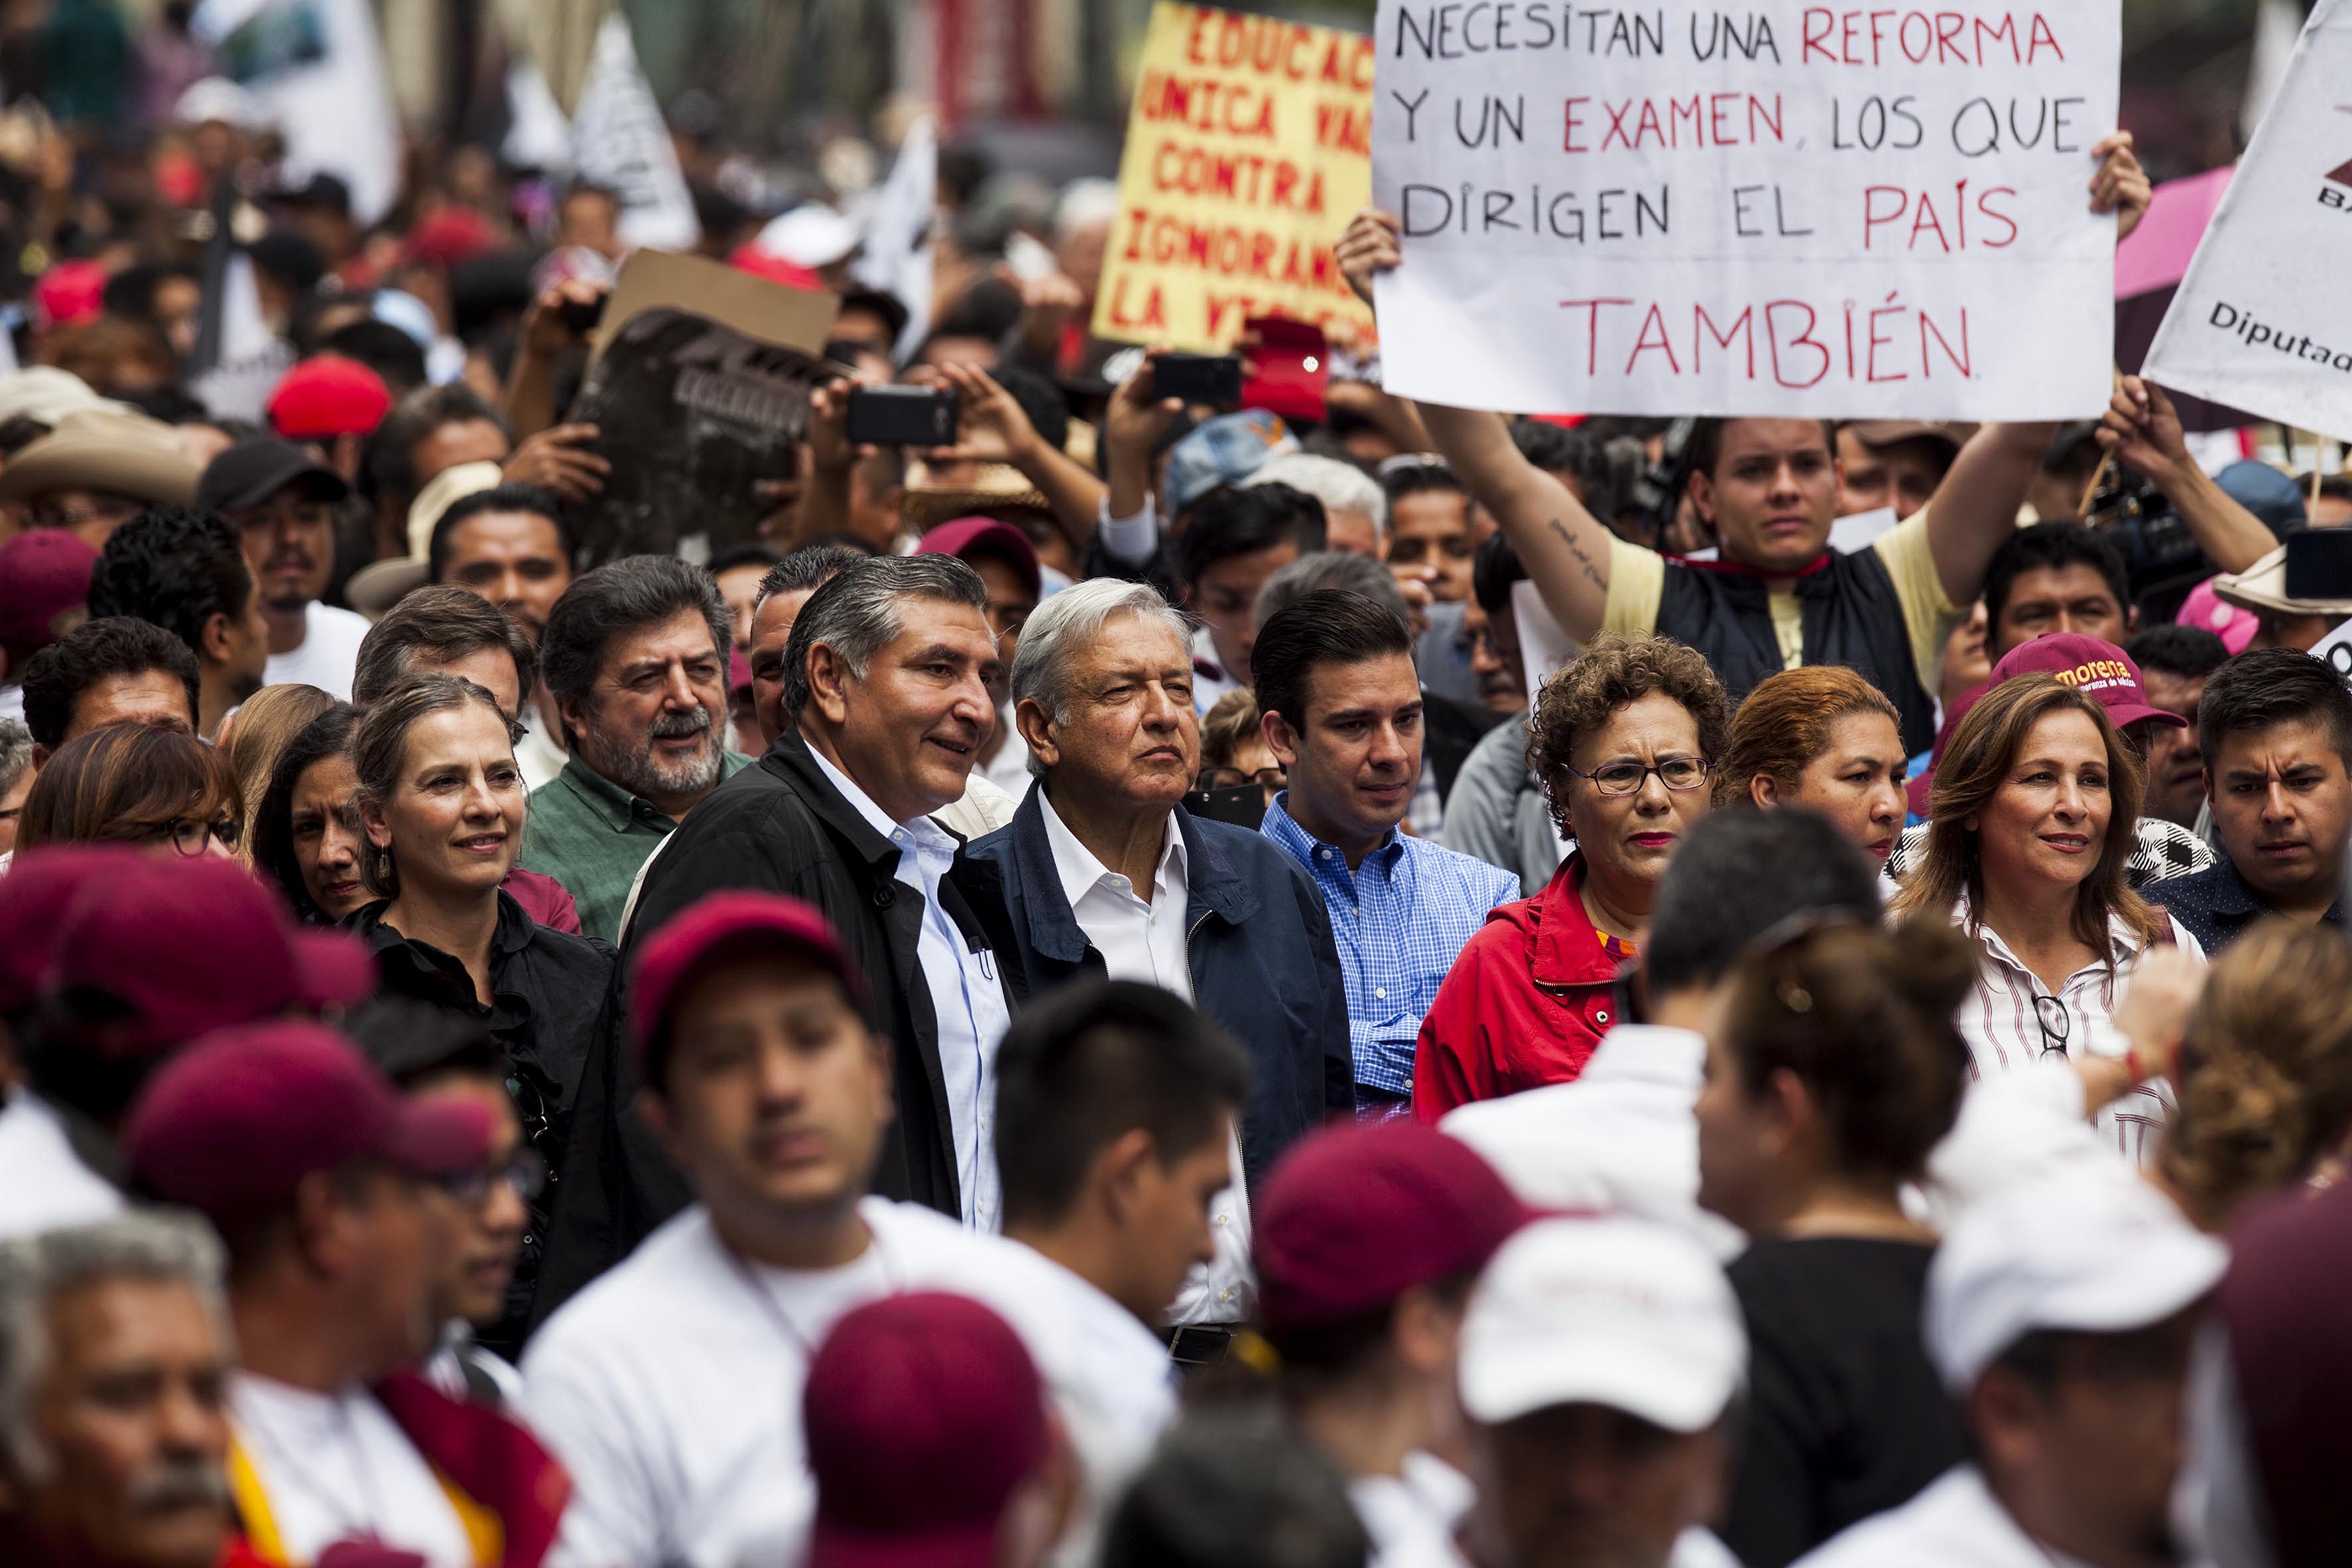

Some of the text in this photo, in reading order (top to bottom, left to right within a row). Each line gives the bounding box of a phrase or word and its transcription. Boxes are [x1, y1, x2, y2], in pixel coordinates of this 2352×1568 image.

[1395, 2, 2065, 66] NECESITAN UNA REFORMA
[1391, 88, 1429, 142] Y
[1454, 94, 1525, 149] UN
[1833, 95, 1923, 151] LOS
[1951, 96, 2086, 157] QUE
[1154, 139, 1326, 216] CONTRA
[1402, 177, 2017, 253] DIRIGEN EL PAÍS
[1109, 274, 1166, 329] LA
